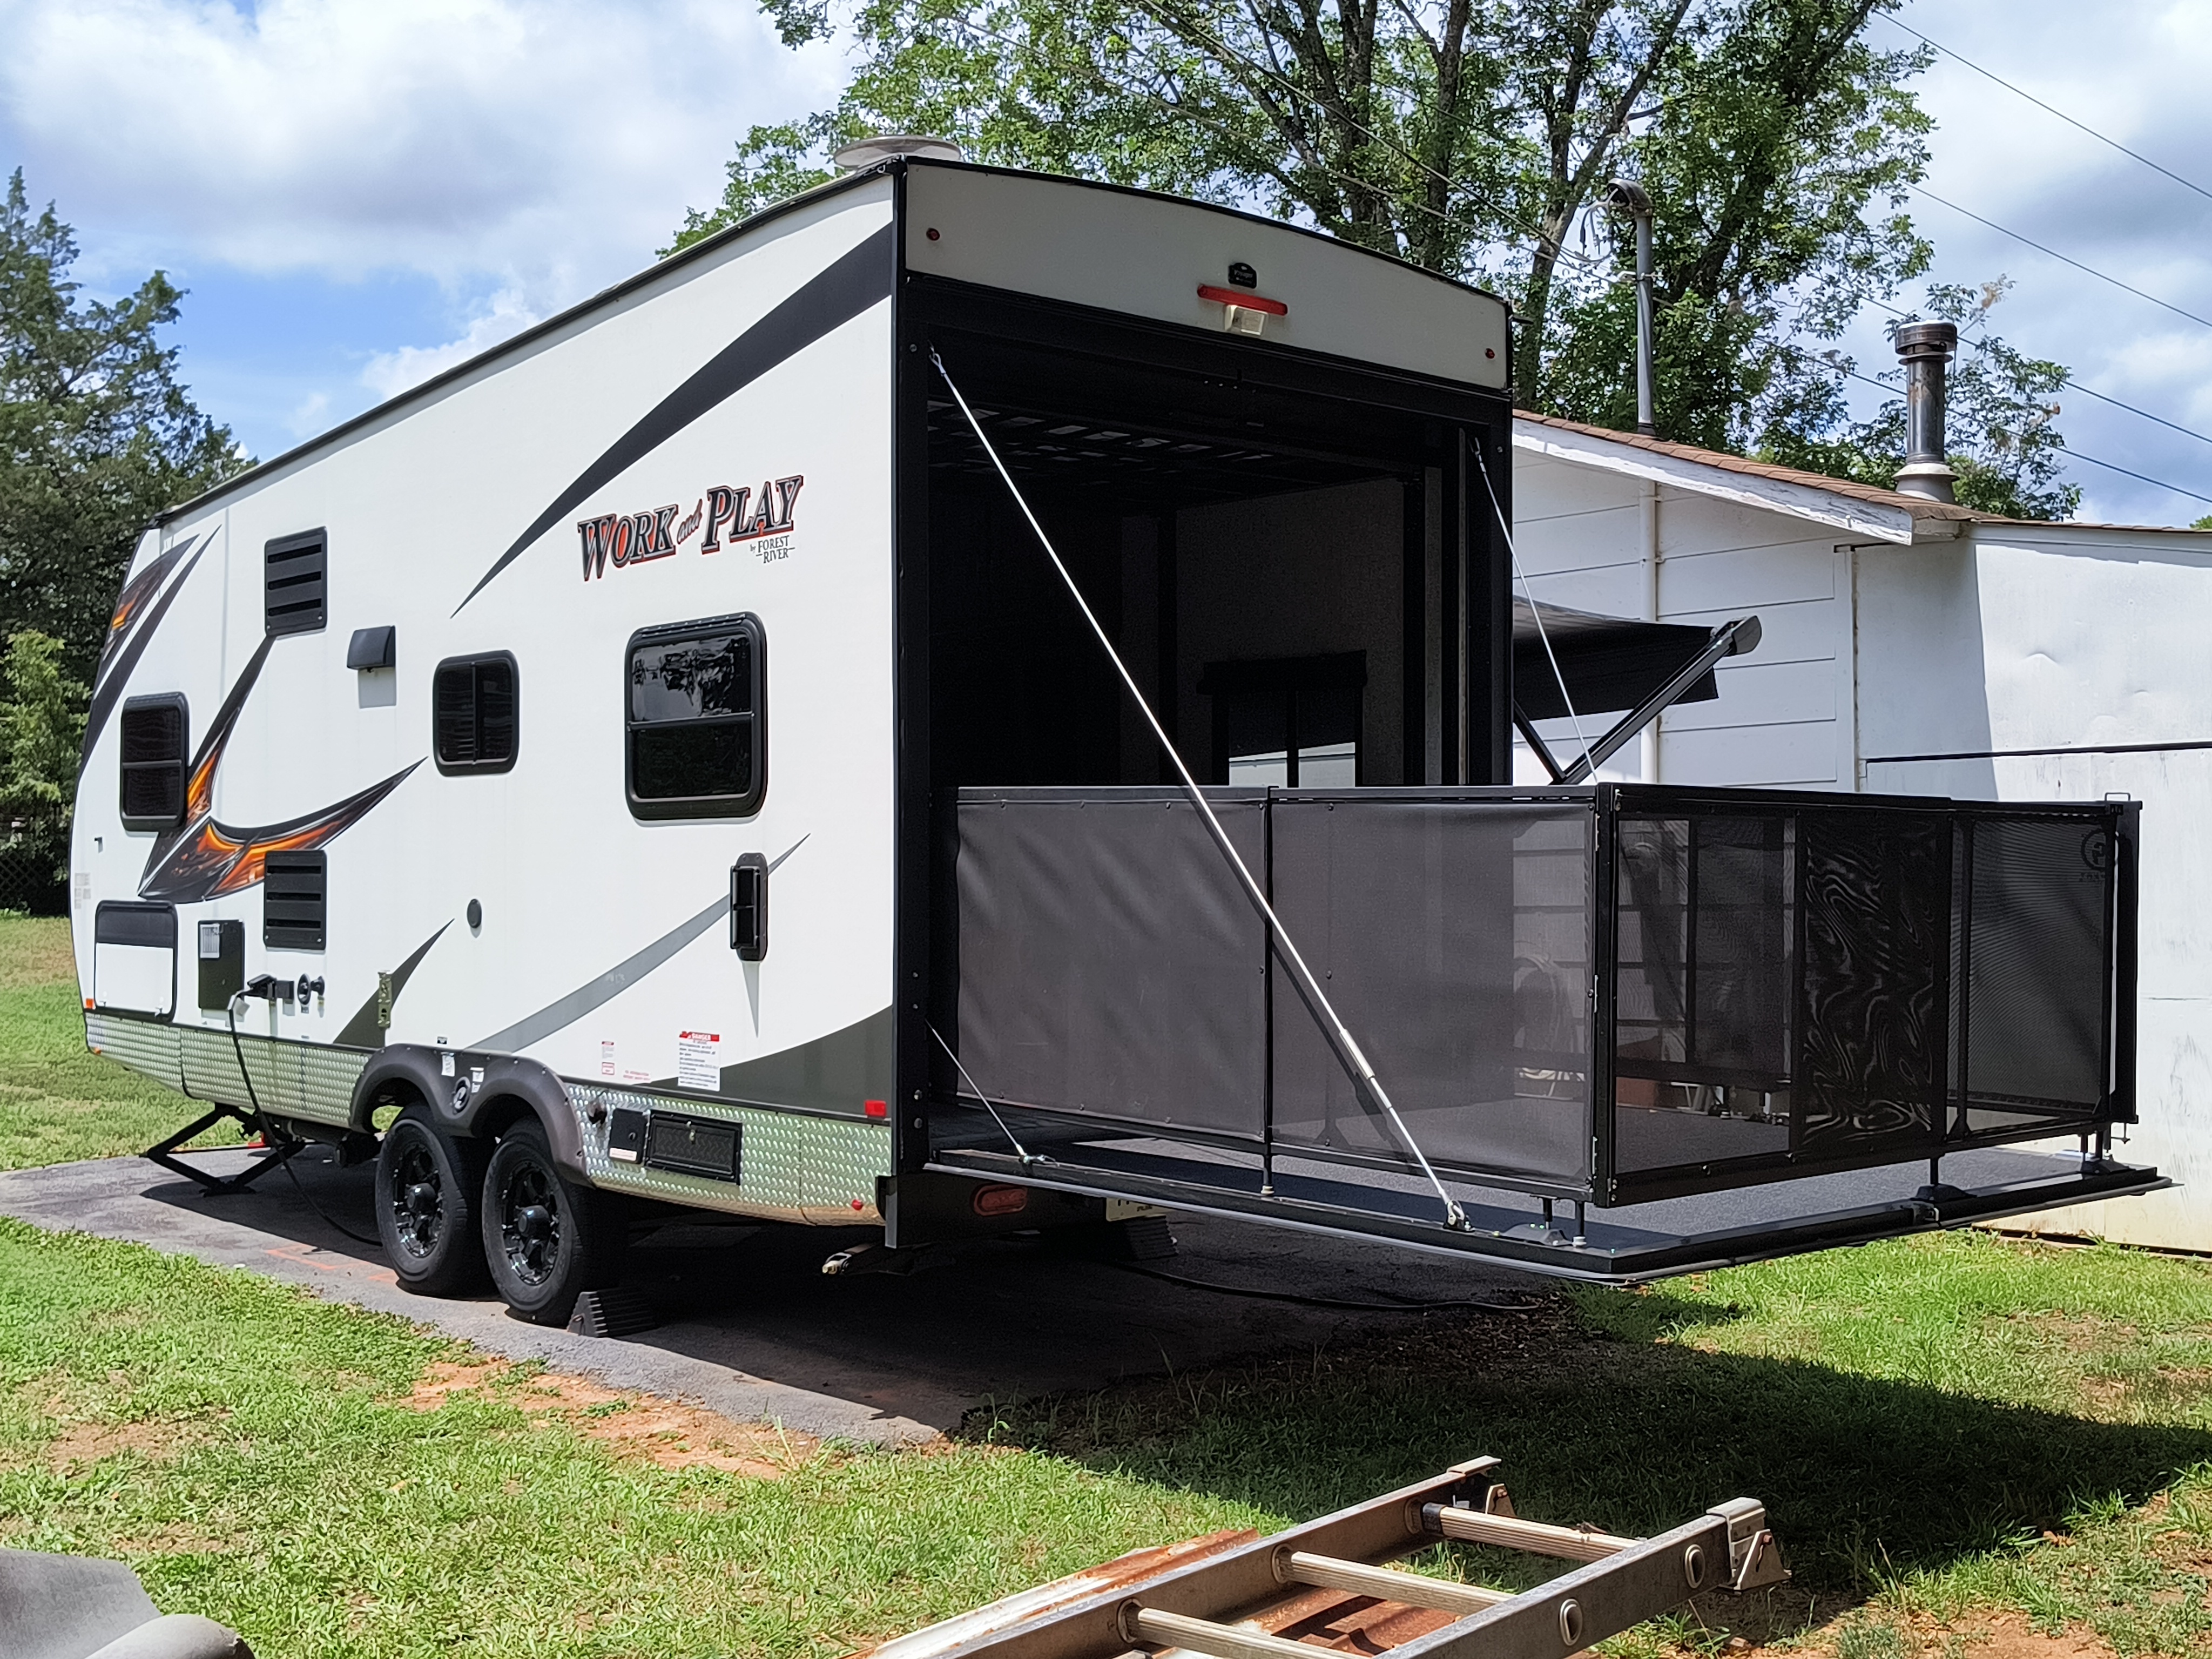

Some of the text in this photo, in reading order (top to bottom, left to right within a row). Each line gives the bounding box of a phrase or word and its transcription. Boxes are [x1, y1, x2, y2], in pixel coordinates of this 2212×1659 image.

[577, 475, 804, 582] WORK and PLAY
[758, 535, 790, 553] FOREST
[763, 548, 789, 564] RIVER
